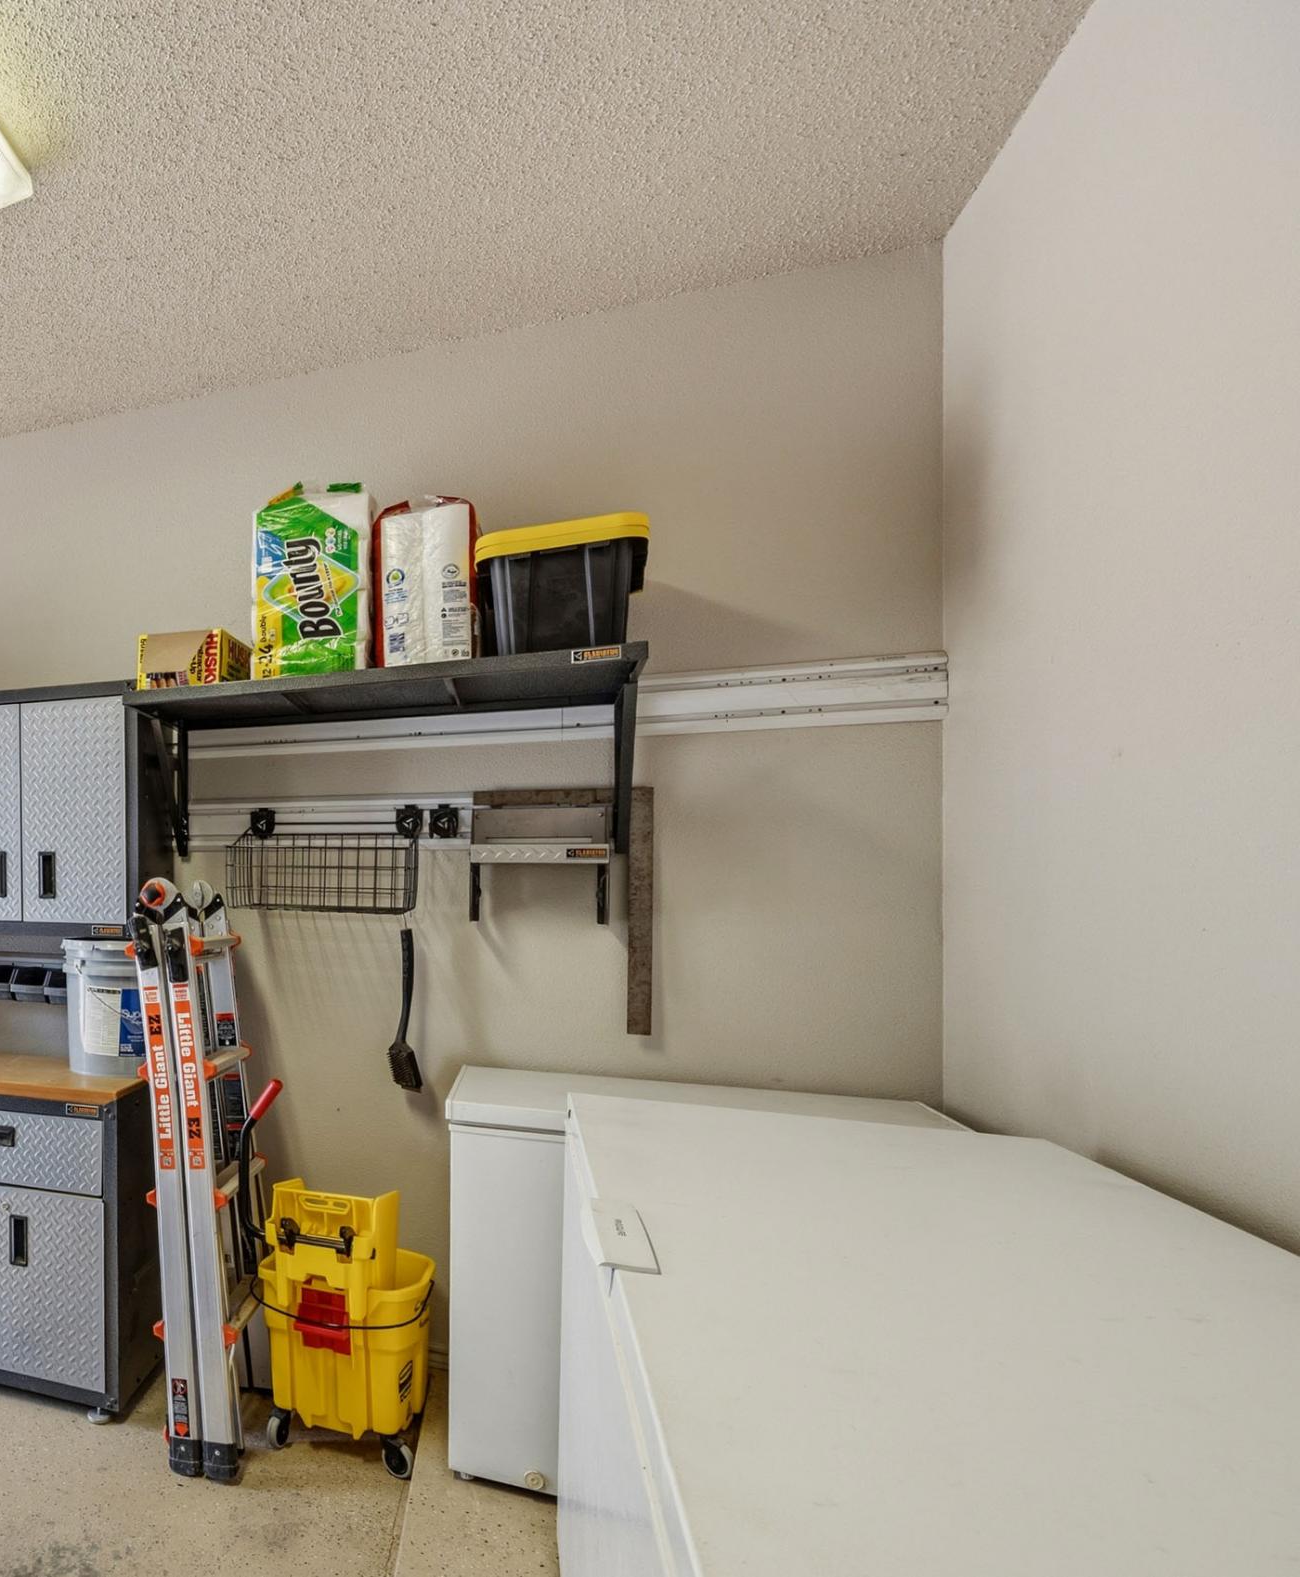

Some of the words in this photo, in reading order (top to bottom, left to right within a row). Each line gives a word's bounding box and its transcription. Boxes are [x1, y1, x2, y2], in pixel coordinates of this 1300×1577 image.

[283, 536, 342, 640] Bounty
[176, 1012, 193, 1057] Little
[152, 1044, 168, 1089] Giant
[182, 1061, 198, 1108] Giant
[157, 1093, 172, 1140] Little
